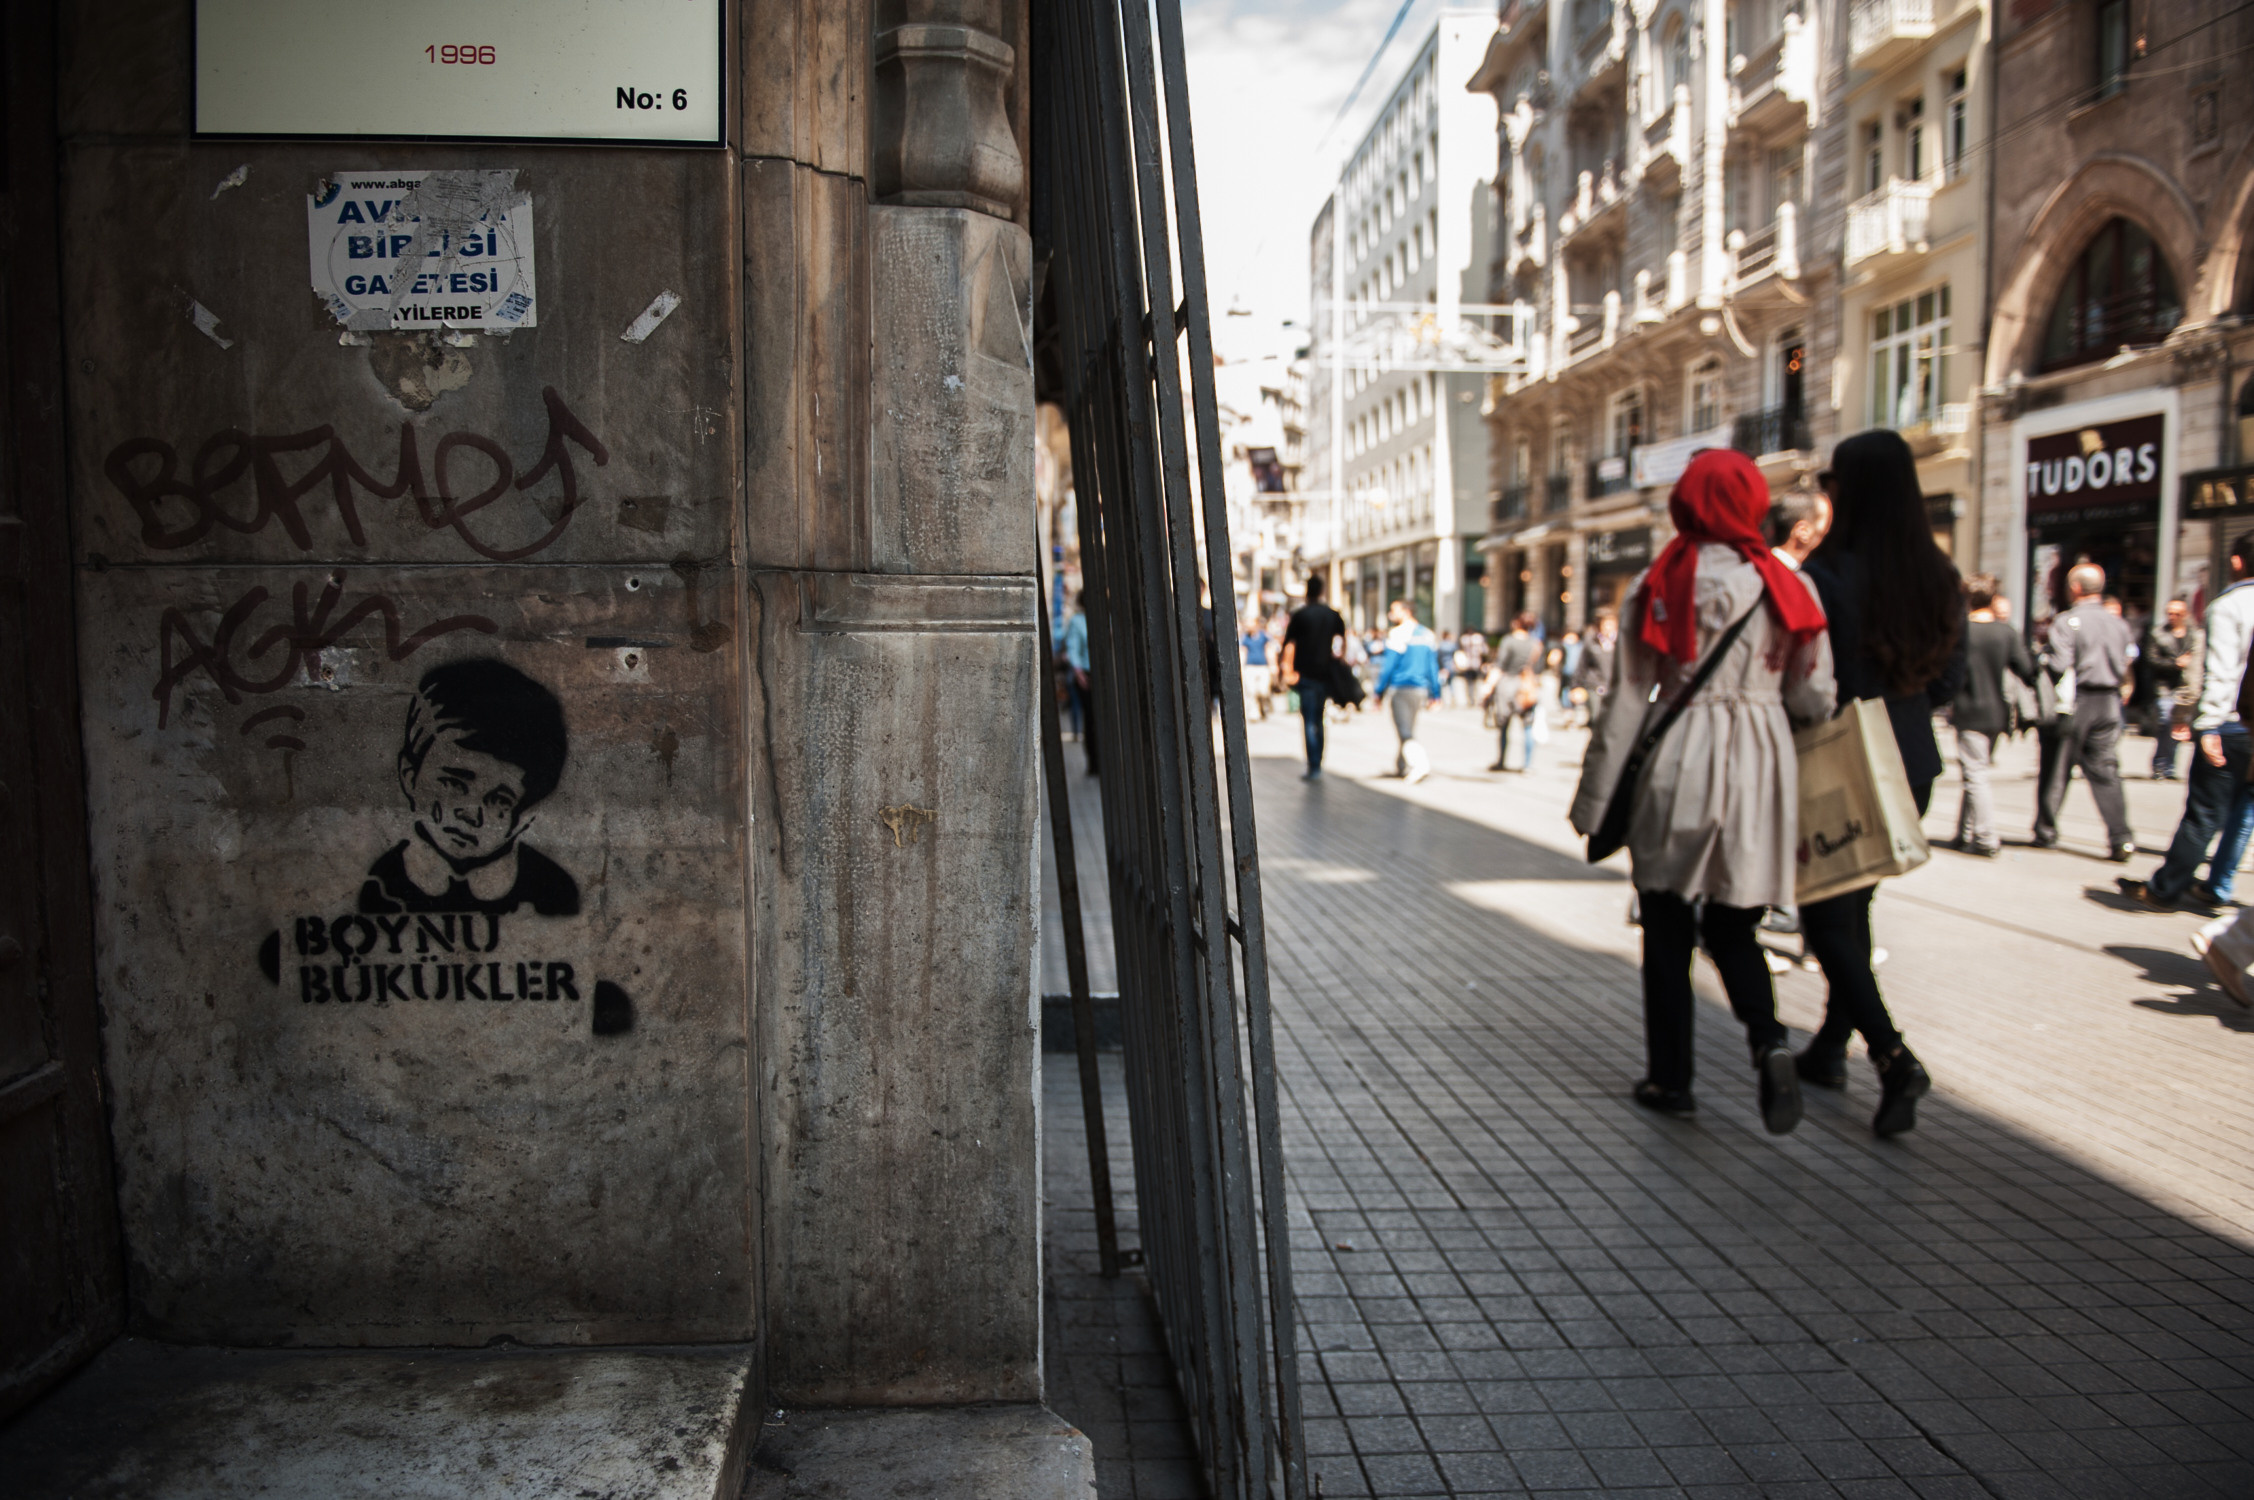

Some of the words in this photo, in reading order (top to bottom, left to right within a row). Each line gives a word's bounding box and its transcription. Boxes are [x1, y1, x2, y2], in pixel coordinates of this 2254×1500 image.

[425, 44, 496, 65] 1996
[616, 86, 662, 110] No:
[672, 88, 688, 111] 6
[350, 179, 421, 190] www.abga
[345, 268, 498, 296] GAETESİ
[2027, 442, 2157, 498] TUDORS
[295, 914, 500, 955] BOYNU
[299, 955, 580, 1003] BÜKÜKLER
